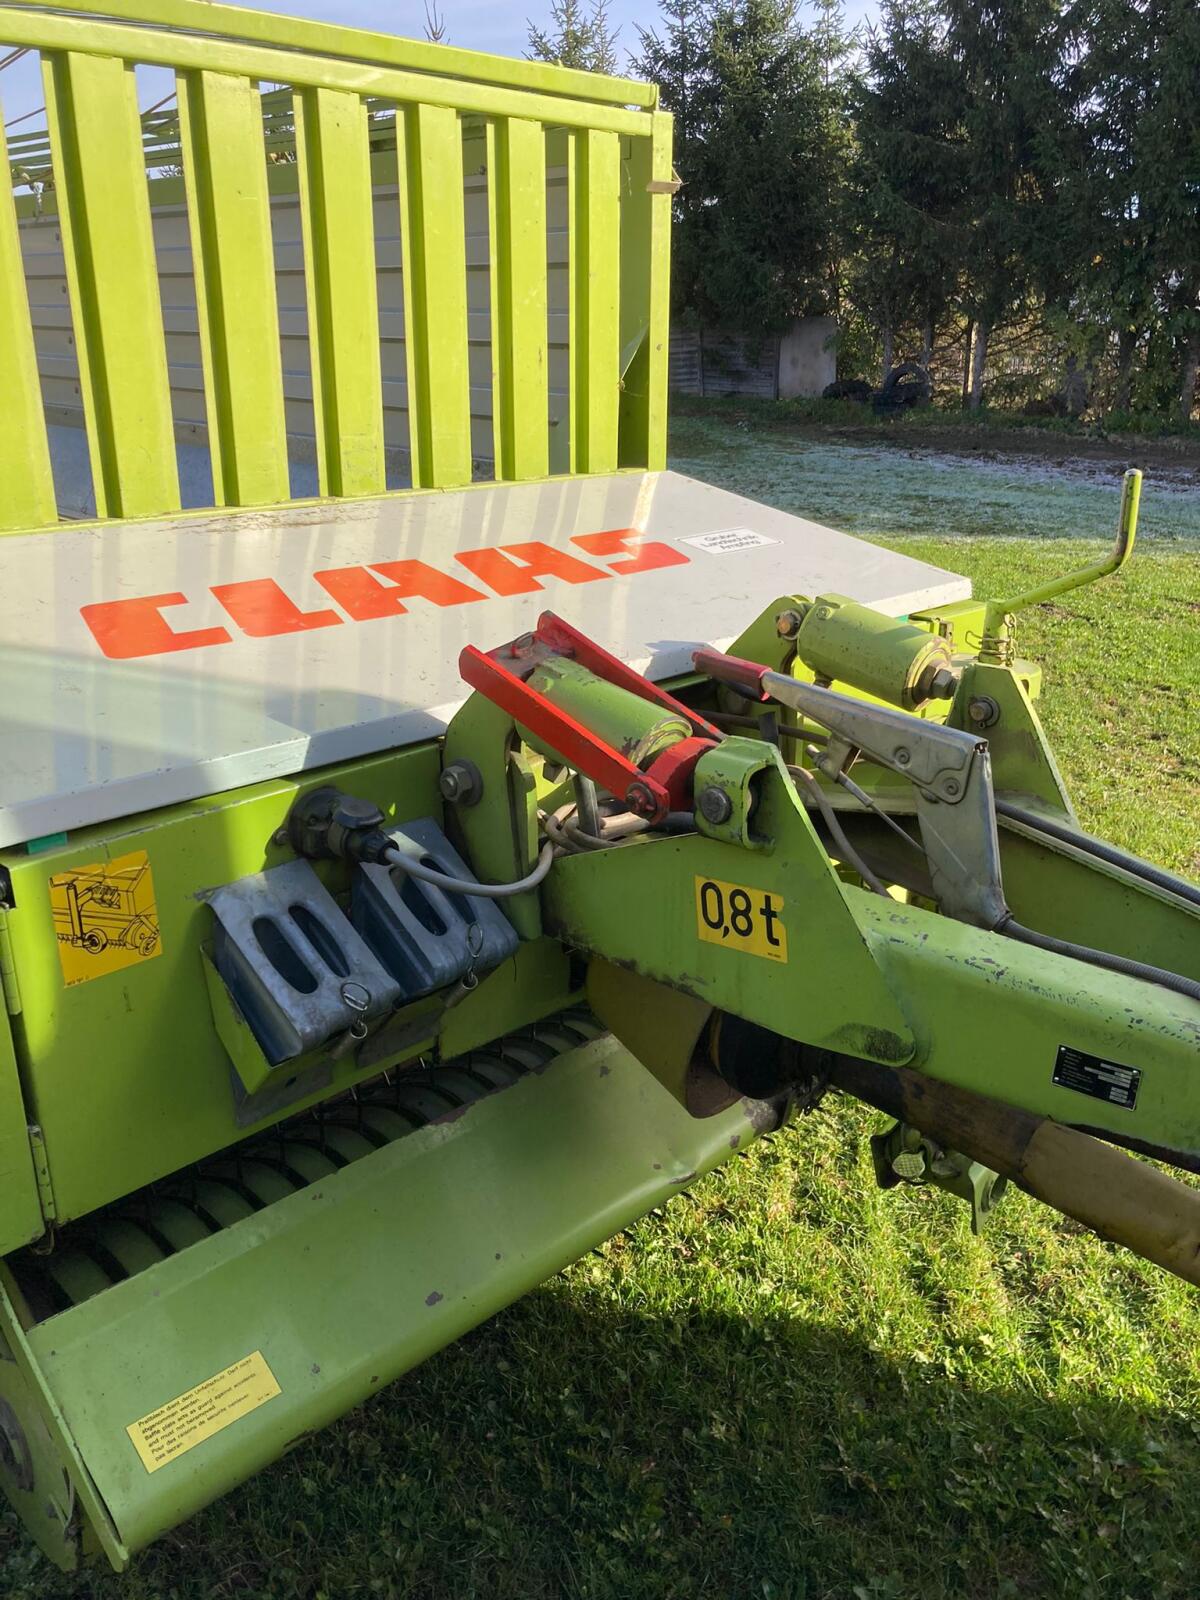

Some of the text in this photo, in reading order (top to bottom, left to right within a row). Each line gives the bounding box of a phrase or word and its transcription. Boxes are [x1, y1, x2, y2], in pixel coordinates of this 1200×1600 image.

[80, 528, 691, 659] CLAAS
[700, 881, 780, 946] 0,8 t
[181, 1393, 193, 1402] dem
[145, 1428, 161, 1441] Baffle
[177, 1412, 188, 1422] acts
[197, 1398, 213, 1410] guard
[148, 1438, 159, 1447] and
[175, 1422, 185, 1431] not
